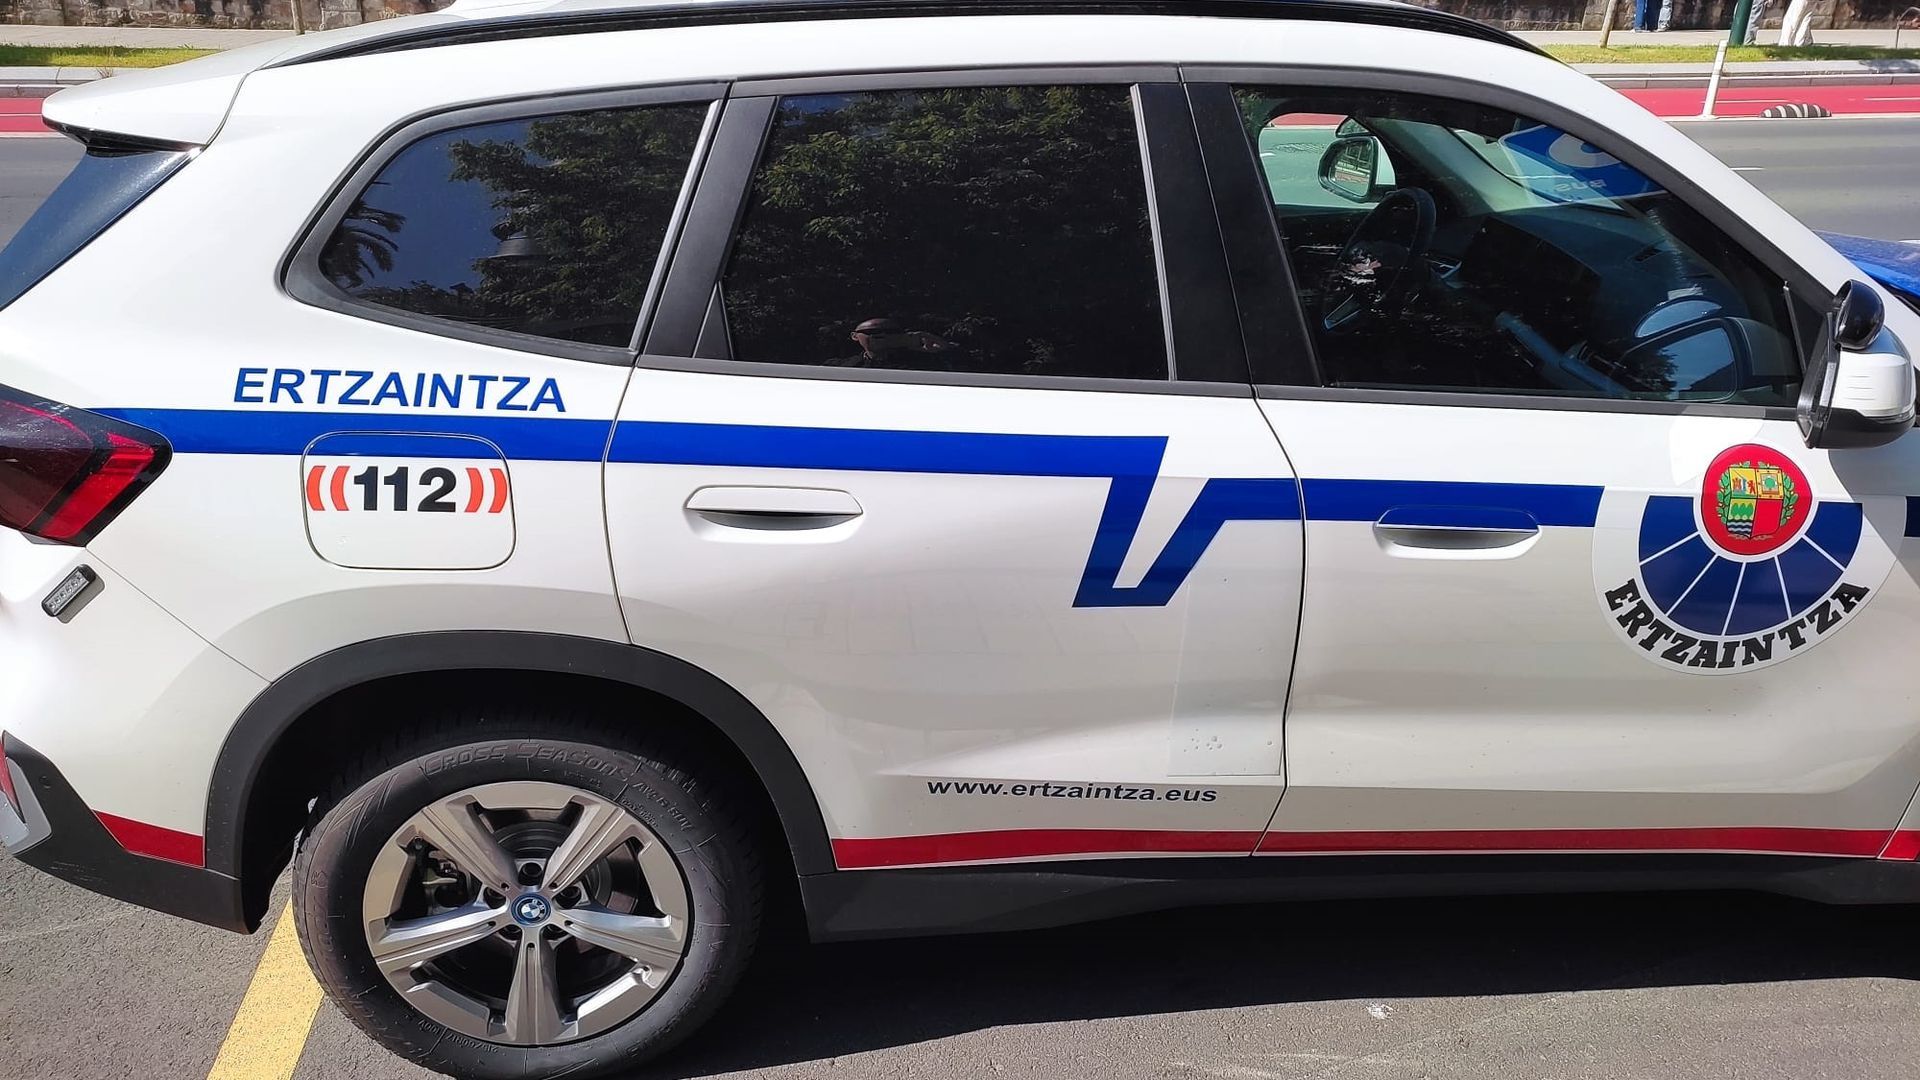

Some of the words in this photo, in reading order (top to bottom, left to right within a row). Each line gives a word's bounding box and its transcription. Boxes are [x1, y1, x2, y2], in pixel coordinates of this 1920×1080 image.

[233, 367, 567, 413] ERTZAINTZA
[1604, 577, 1871, 669] ERTZAINTZA
[926, 781, 1218, 803] www.ertzaintza.eus
